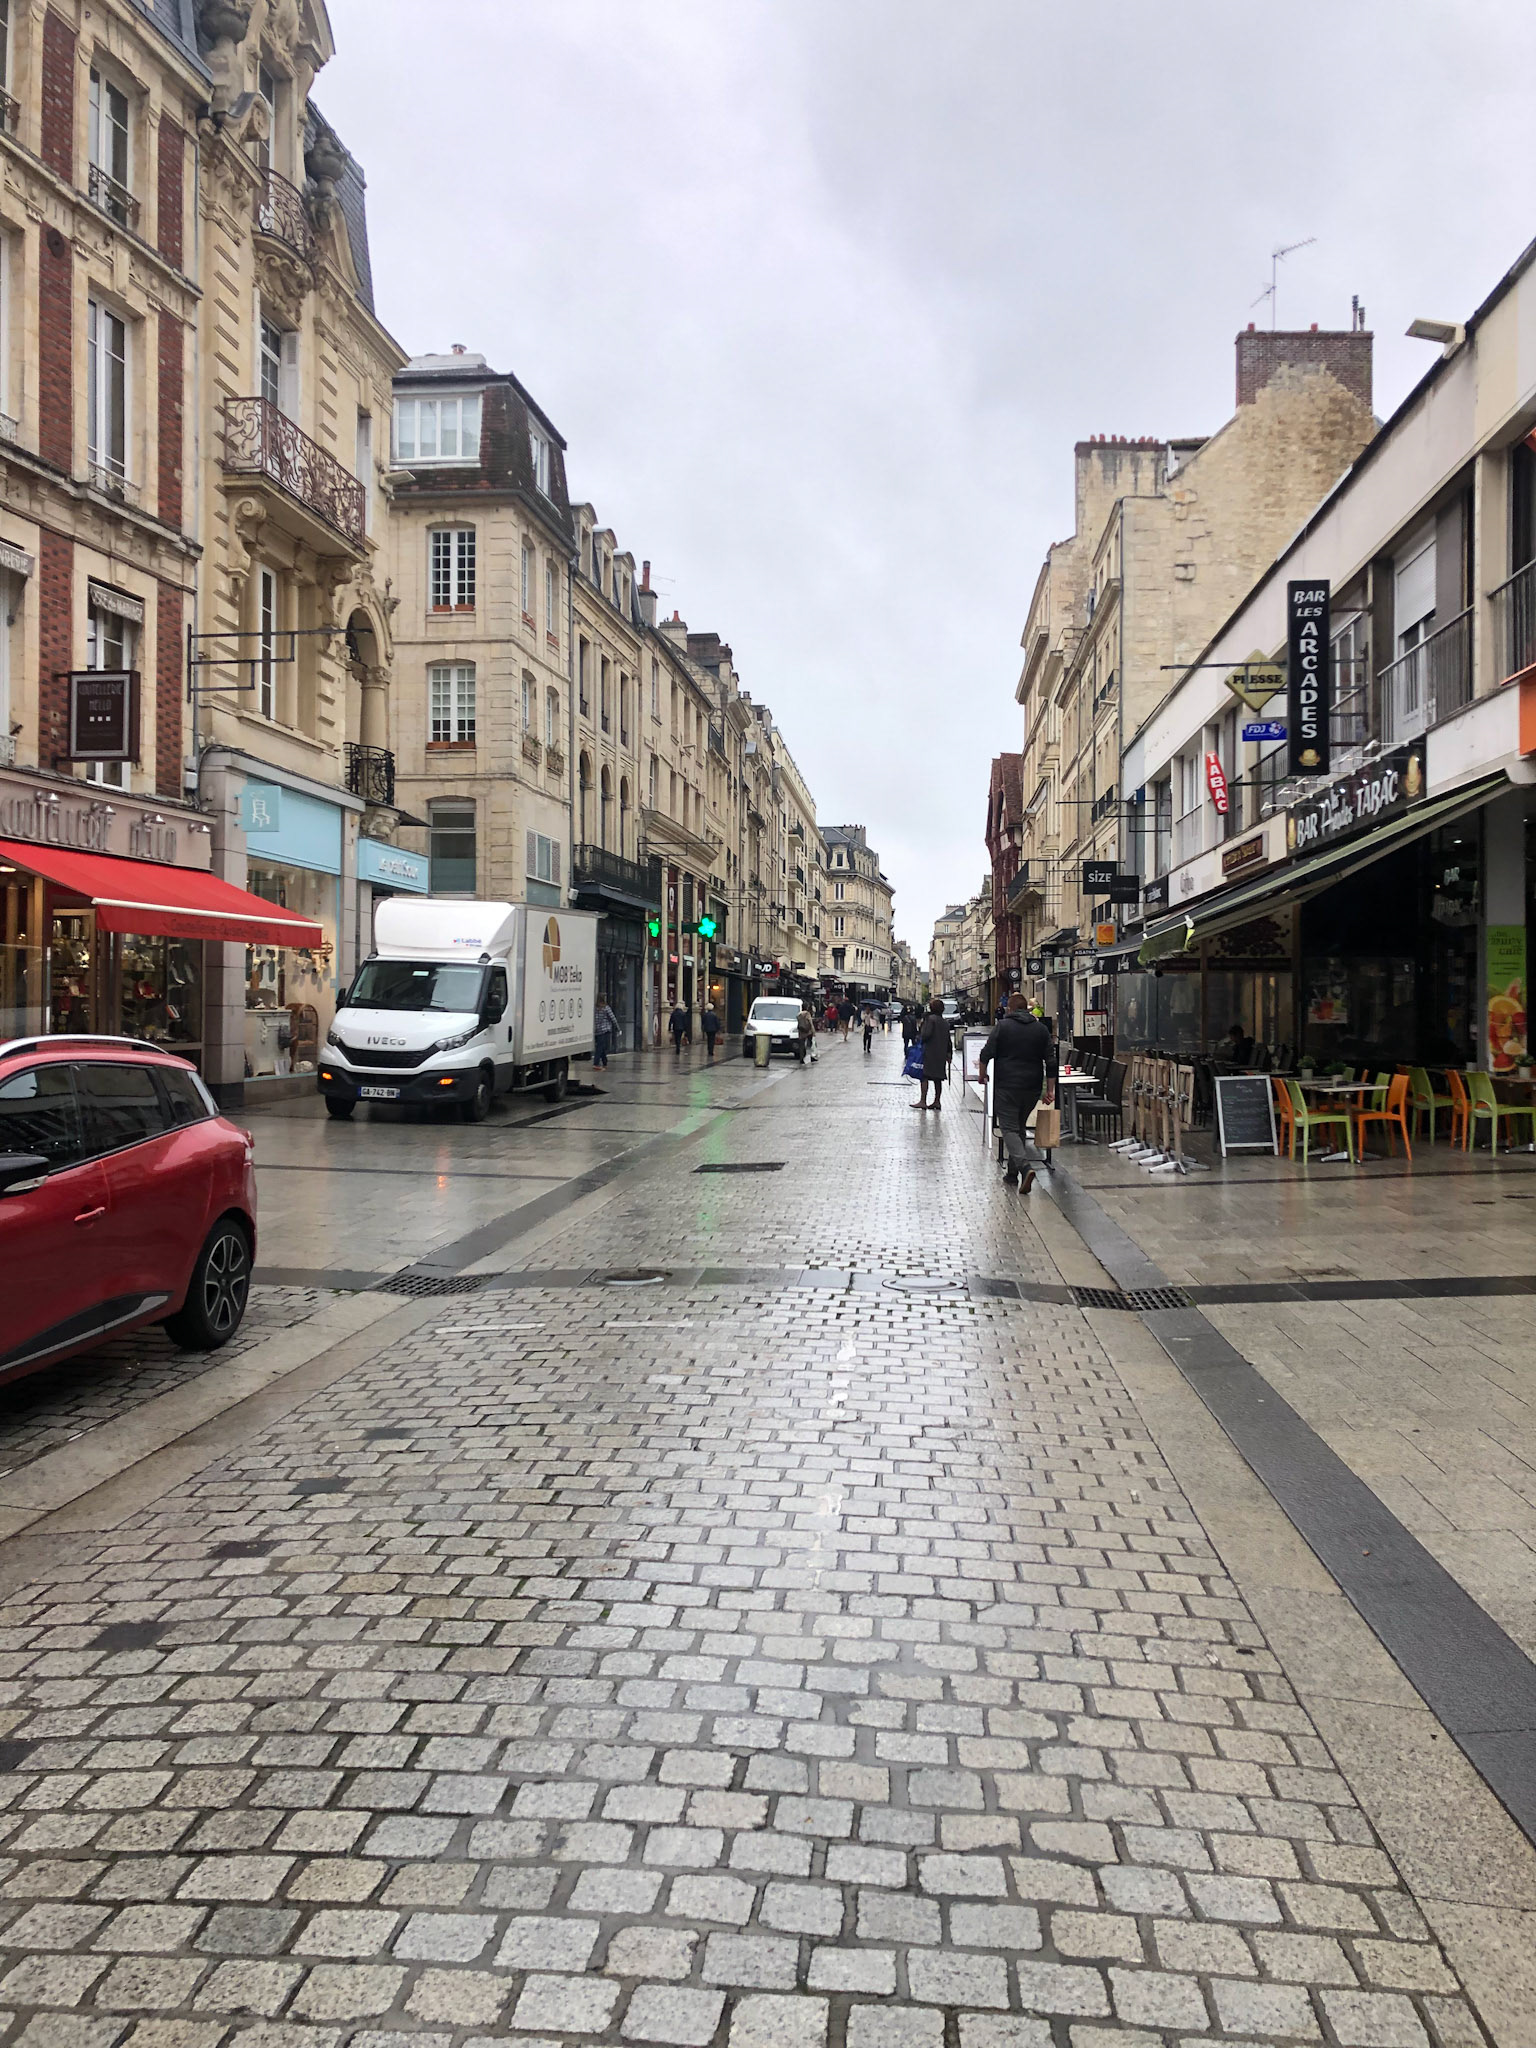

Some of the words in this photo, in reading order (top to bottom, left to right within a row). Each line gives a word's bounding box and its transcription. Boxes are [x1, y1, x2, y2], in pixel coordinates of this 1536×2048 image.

[1294, 590, 1326, 603] BAR
[1296, 607, 1323, 617] LES
[1232, 674, 1283, 685] PRESSE
[1299, 621, 1319, 739] ARCADES
[1248, 723, 1267, 735] FDJ
[1206, 752, 1228, 811] TABAC
[1297, 812, 1318, 847] BAR
[1356, 771, 1399, 817] TABAC
[367, 1036, 407, 1046] IVECO
